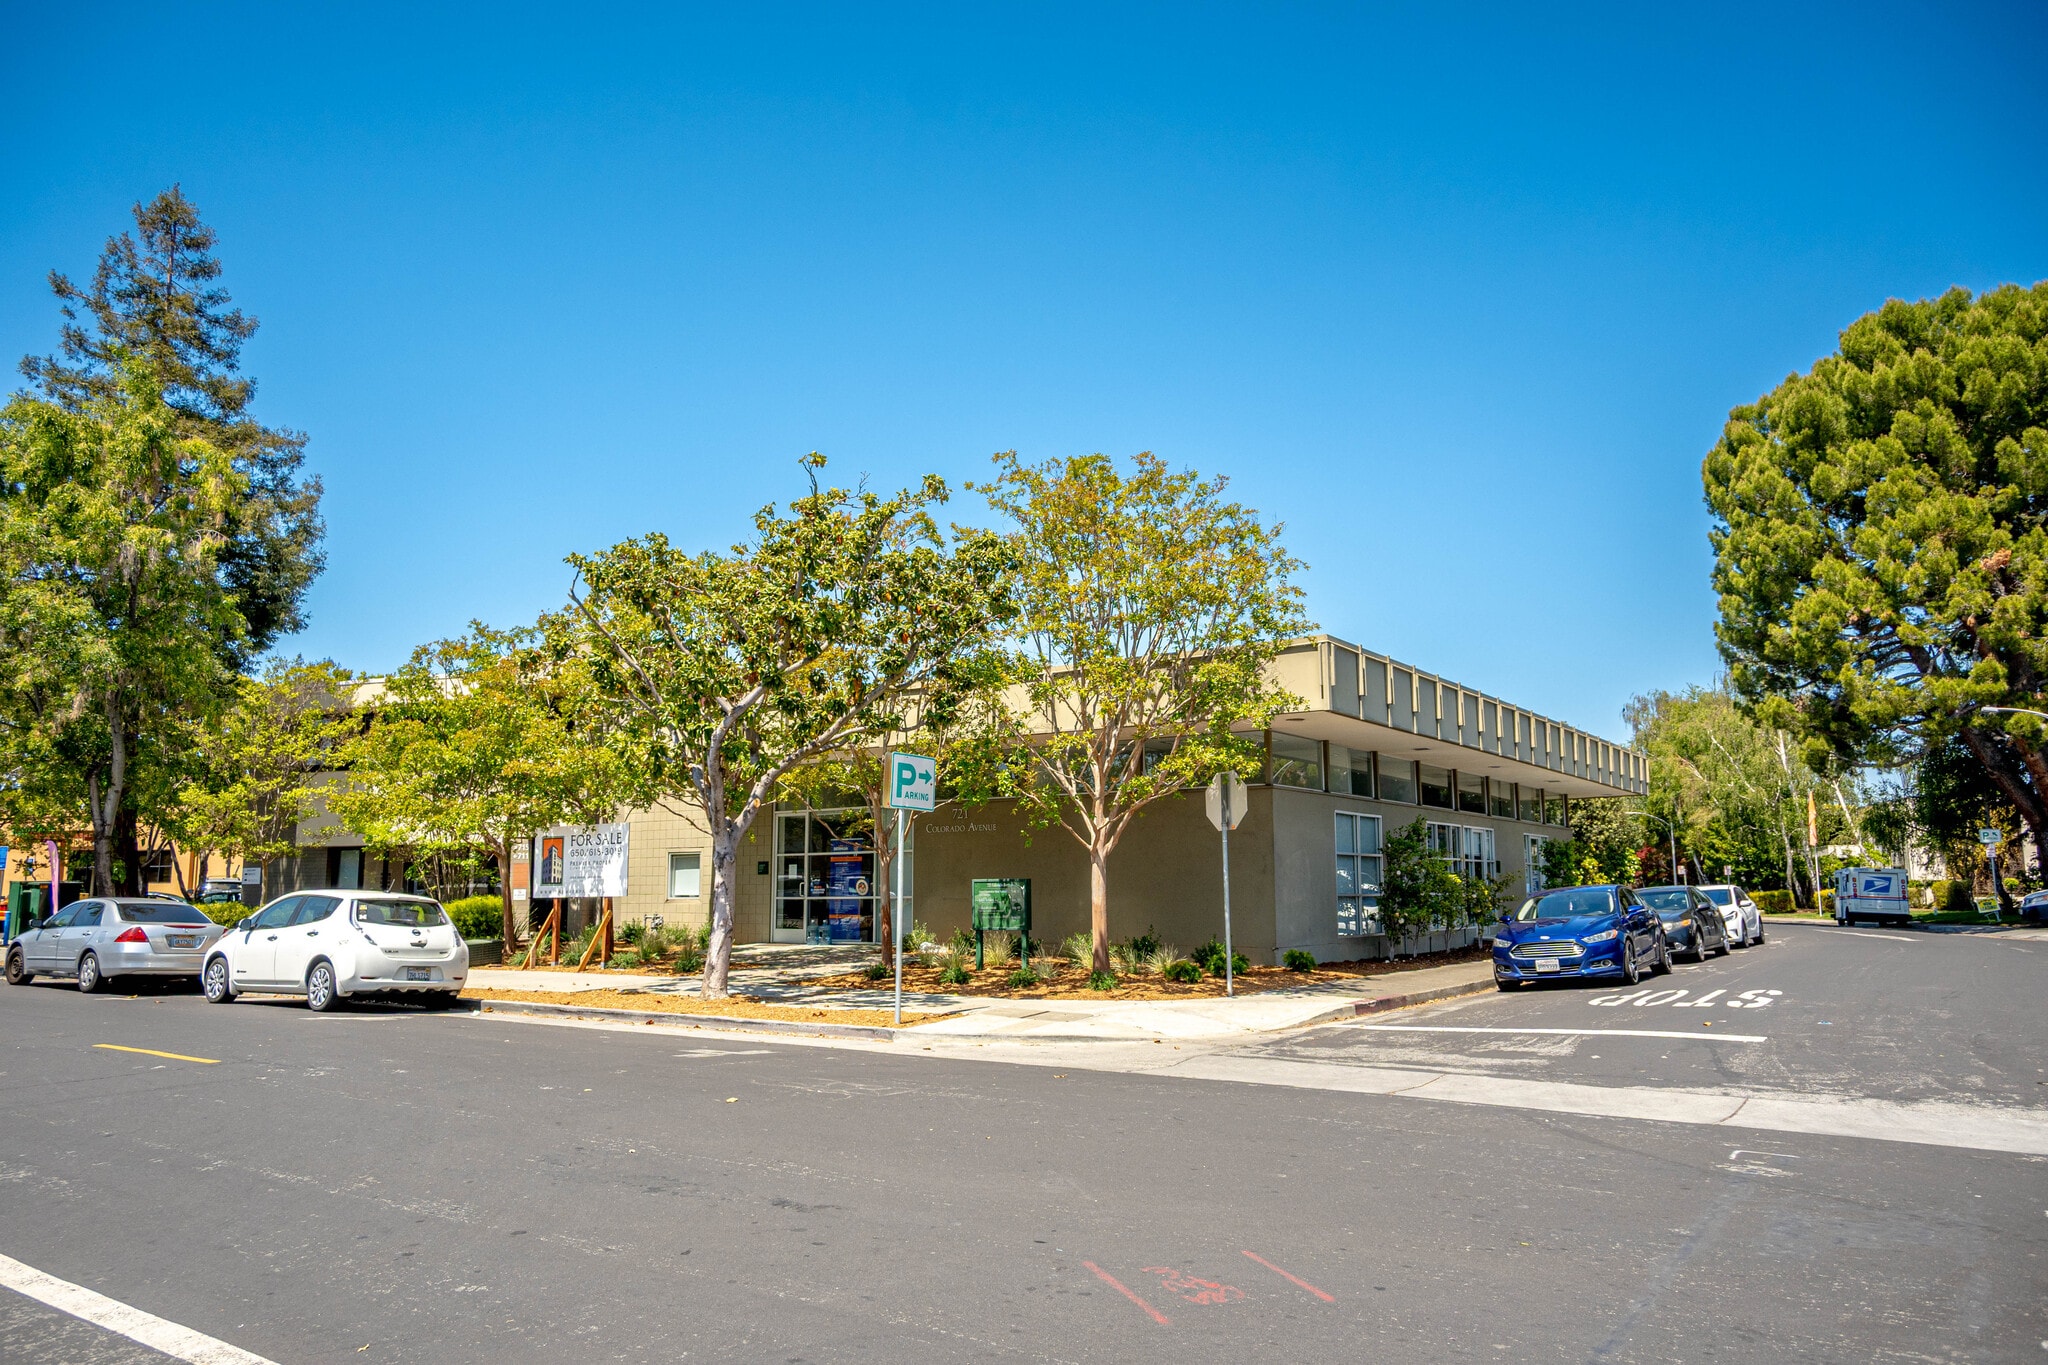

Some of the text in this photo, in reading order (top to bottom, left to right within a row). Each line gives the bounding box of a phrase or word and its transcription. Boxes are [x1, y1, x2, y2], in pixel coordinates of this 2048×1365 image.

[952, 808, 968, 819] 721
[968, 822, 997, 832] AVENUE
[570, 832, 622, 847] FOR SALE
[1588, 989, 1784, 1009] STOP
